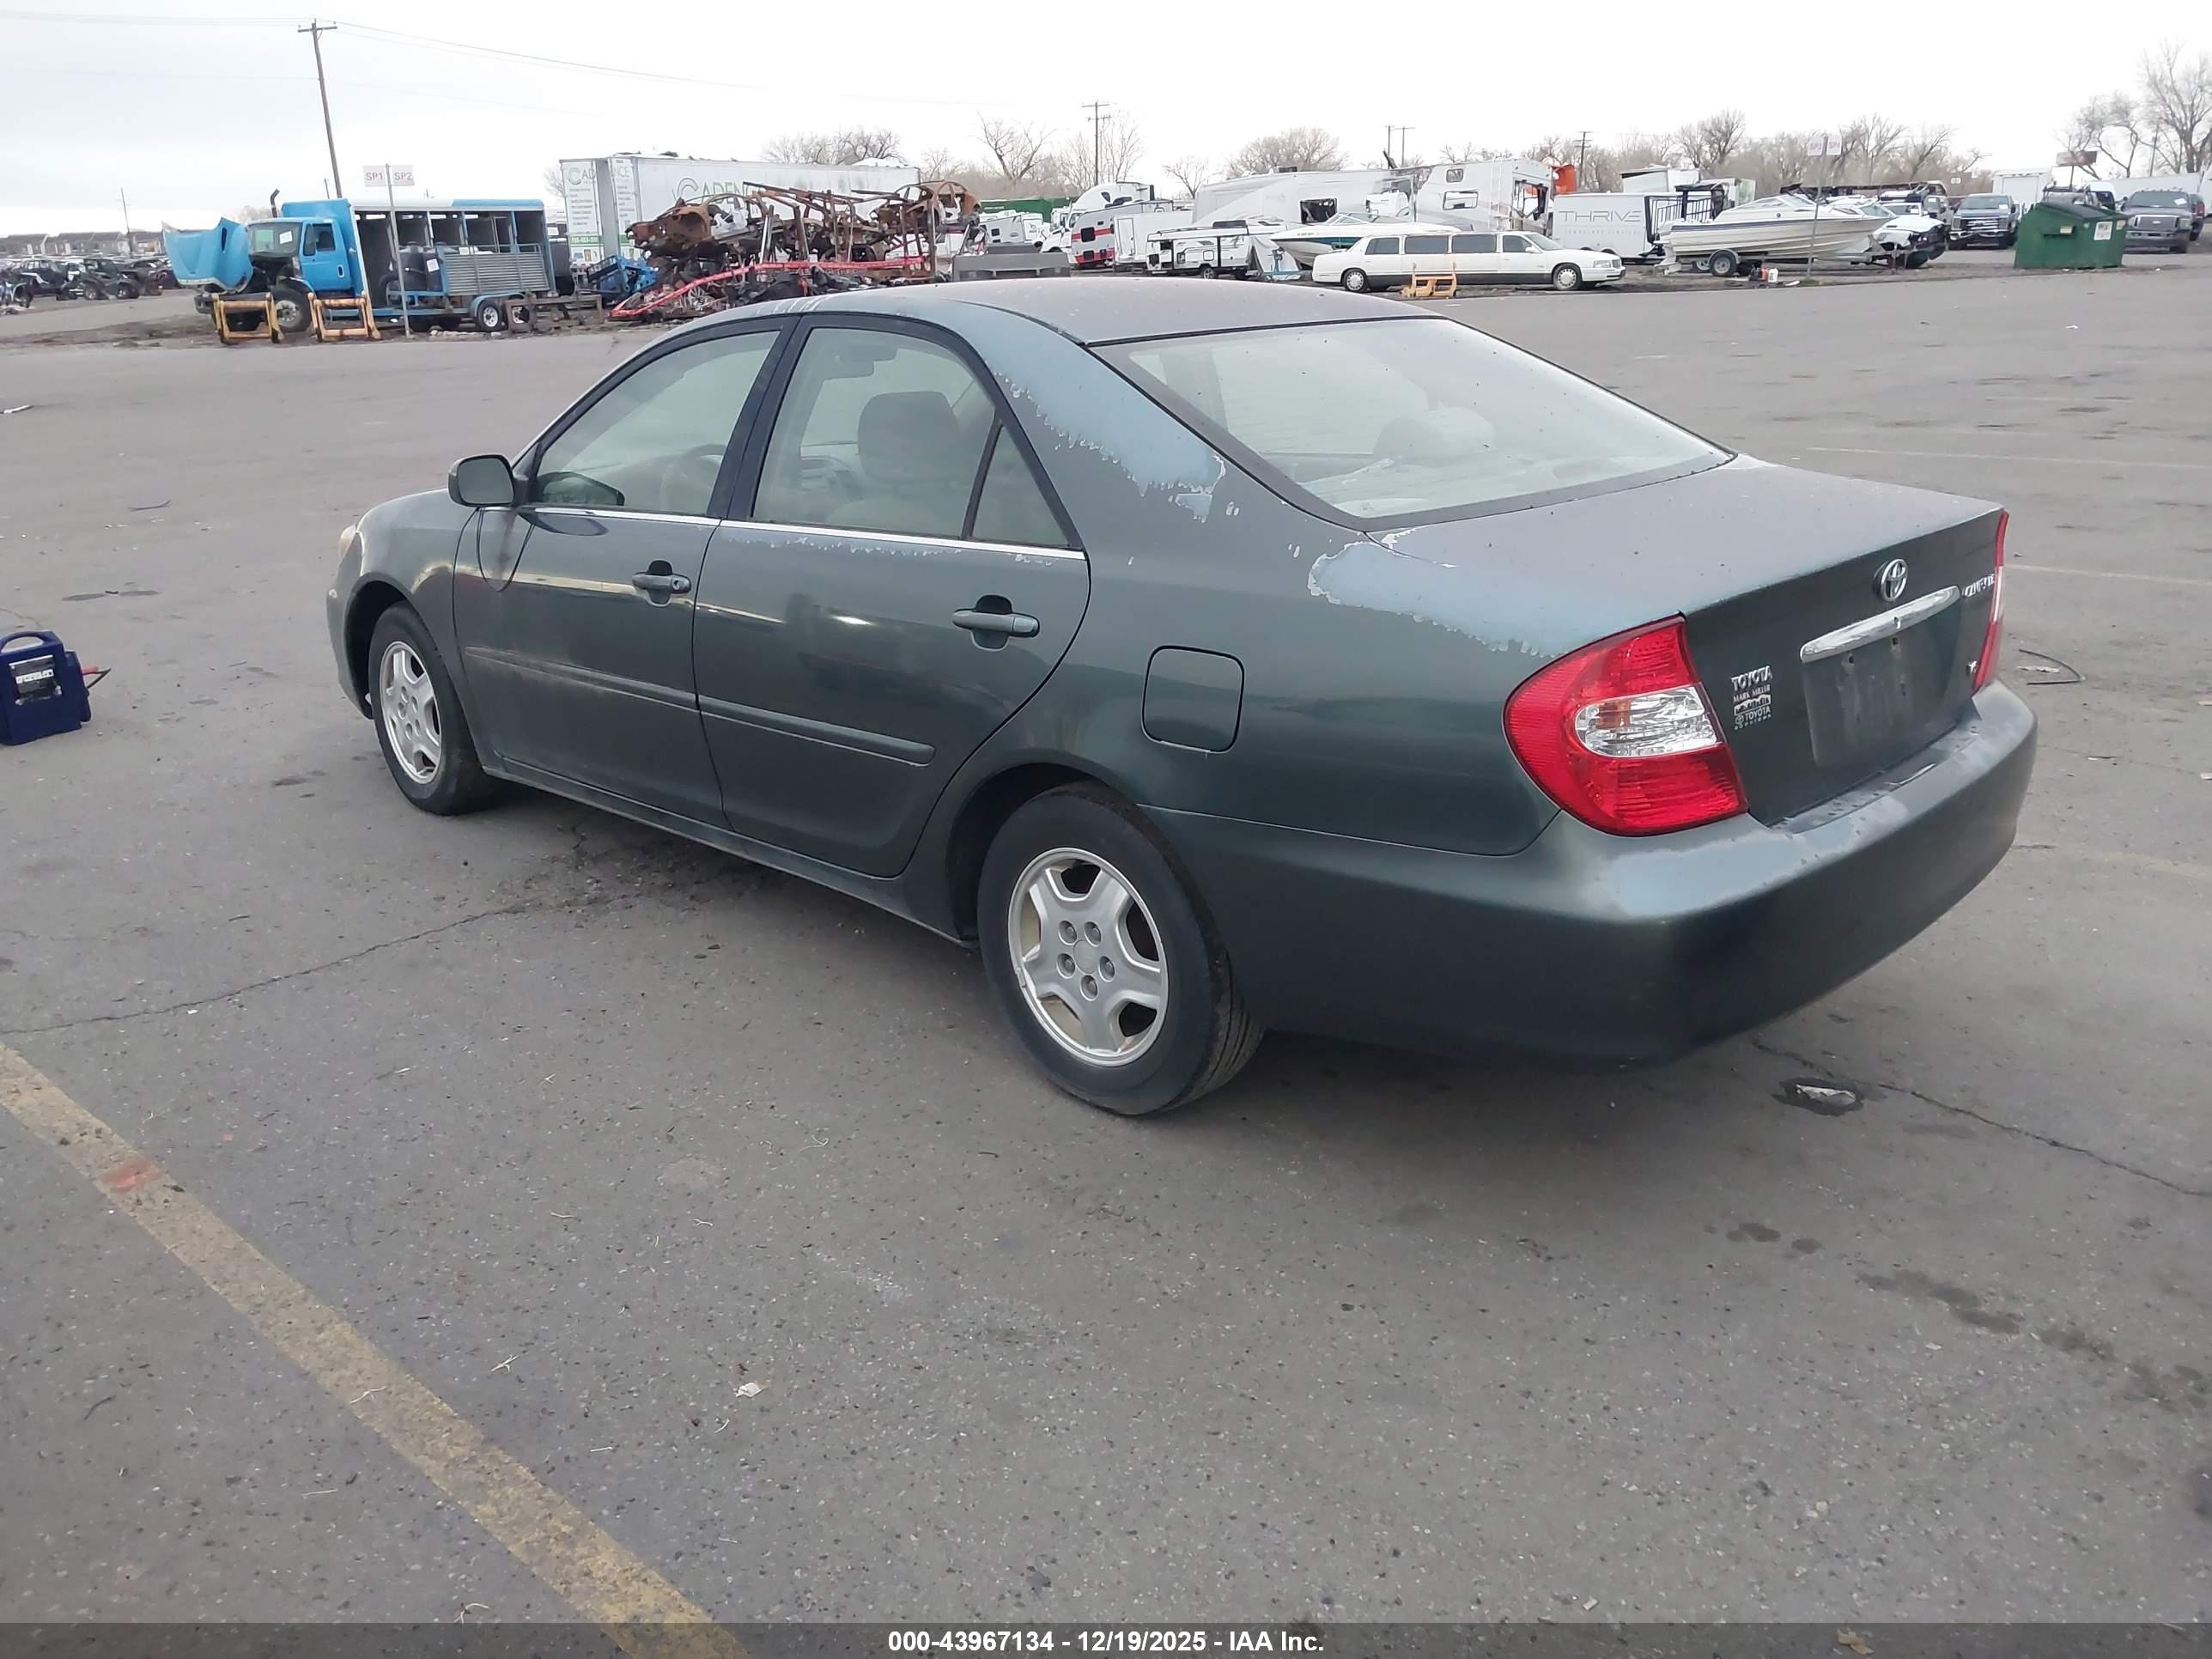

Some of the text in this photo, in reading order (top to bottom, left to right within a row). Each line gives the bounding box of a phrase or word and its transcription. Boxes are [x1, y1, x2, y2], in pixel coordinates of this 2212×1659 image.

[366, 172, 383, 180] SP1
[394, 172, 412, 180] SP2
[1559, 210, 1642, 222] THRIVE
[1731, 665, 1773, 691] TOYOTA
[1733, 684, 1771, 703] MARK MILLER
[1745, 706, 1771, 721] TOYOTA
